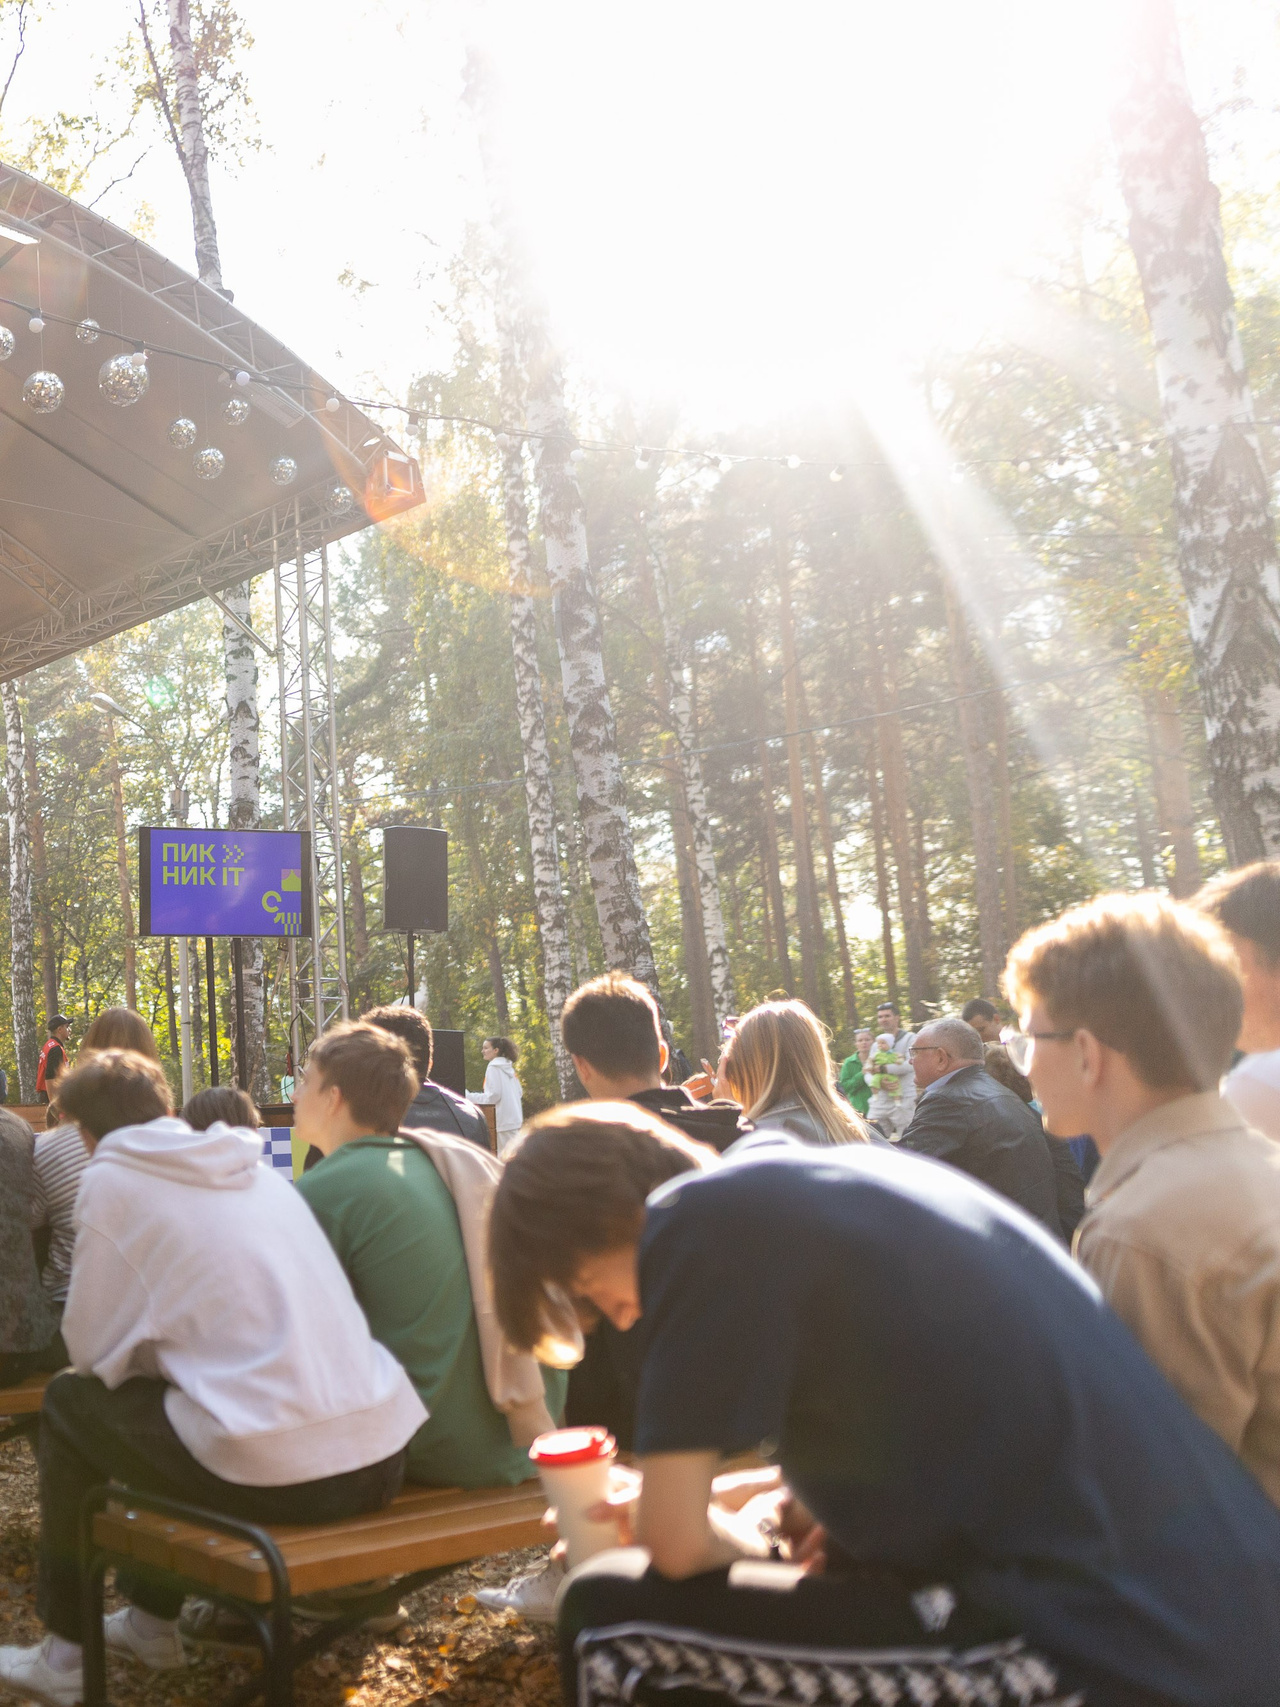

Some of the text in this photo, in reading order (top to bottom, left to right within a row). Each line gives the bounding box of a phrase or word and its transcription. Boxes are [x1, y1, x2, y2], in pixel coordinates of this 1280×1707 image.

[162, 843, 216, 863] ПИК
[162, 867, 245, 886] НИК IT
